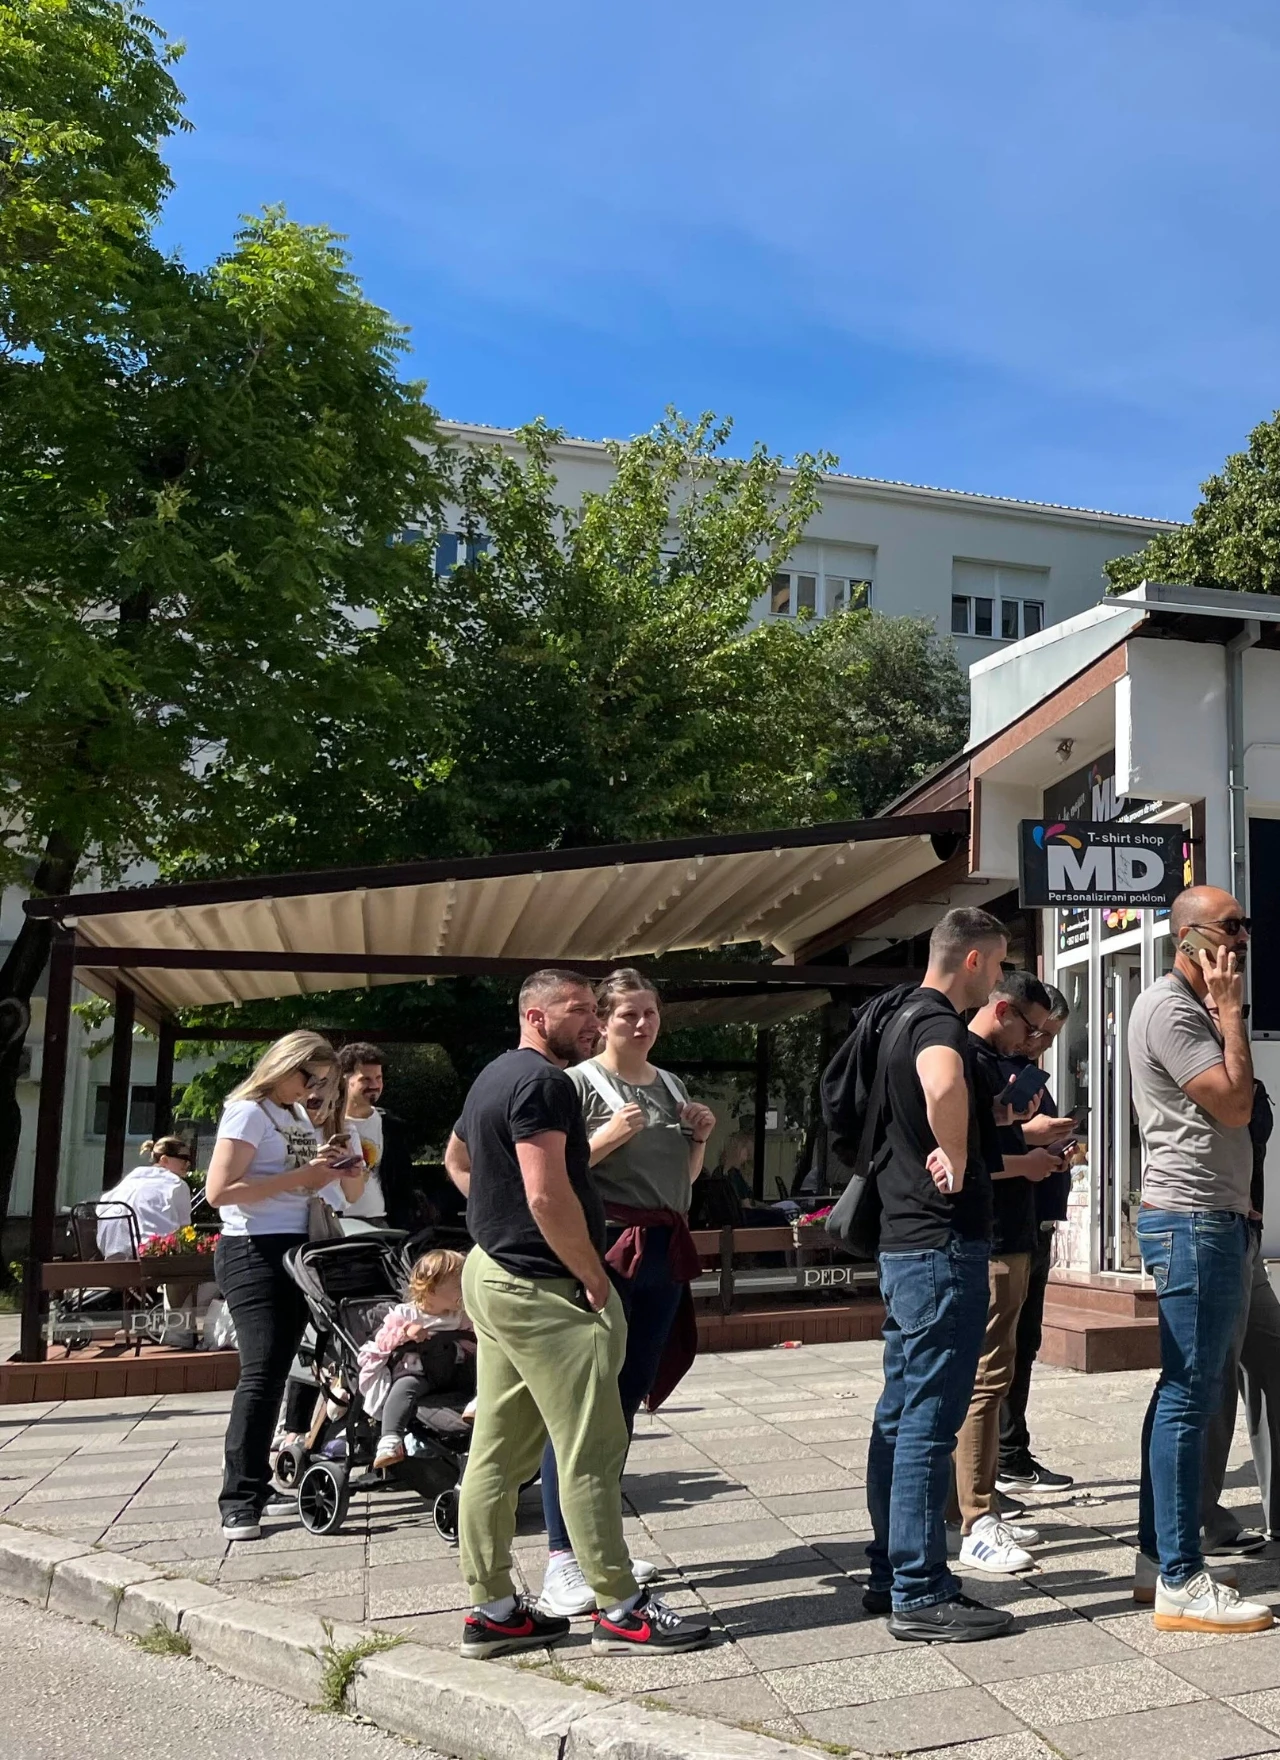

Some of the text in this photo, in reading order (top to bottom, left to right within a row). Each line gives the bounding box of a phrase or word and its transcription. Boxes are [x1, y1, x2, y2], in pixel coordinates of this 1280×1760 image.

[1087, 832, 1165, 846] T-shirt shop
[1047, 845, 1165, 892] MD
[1048, 892, 1166, 904] Personalizirani pokloni
[803, 1267, 853, 1287] PEPI
